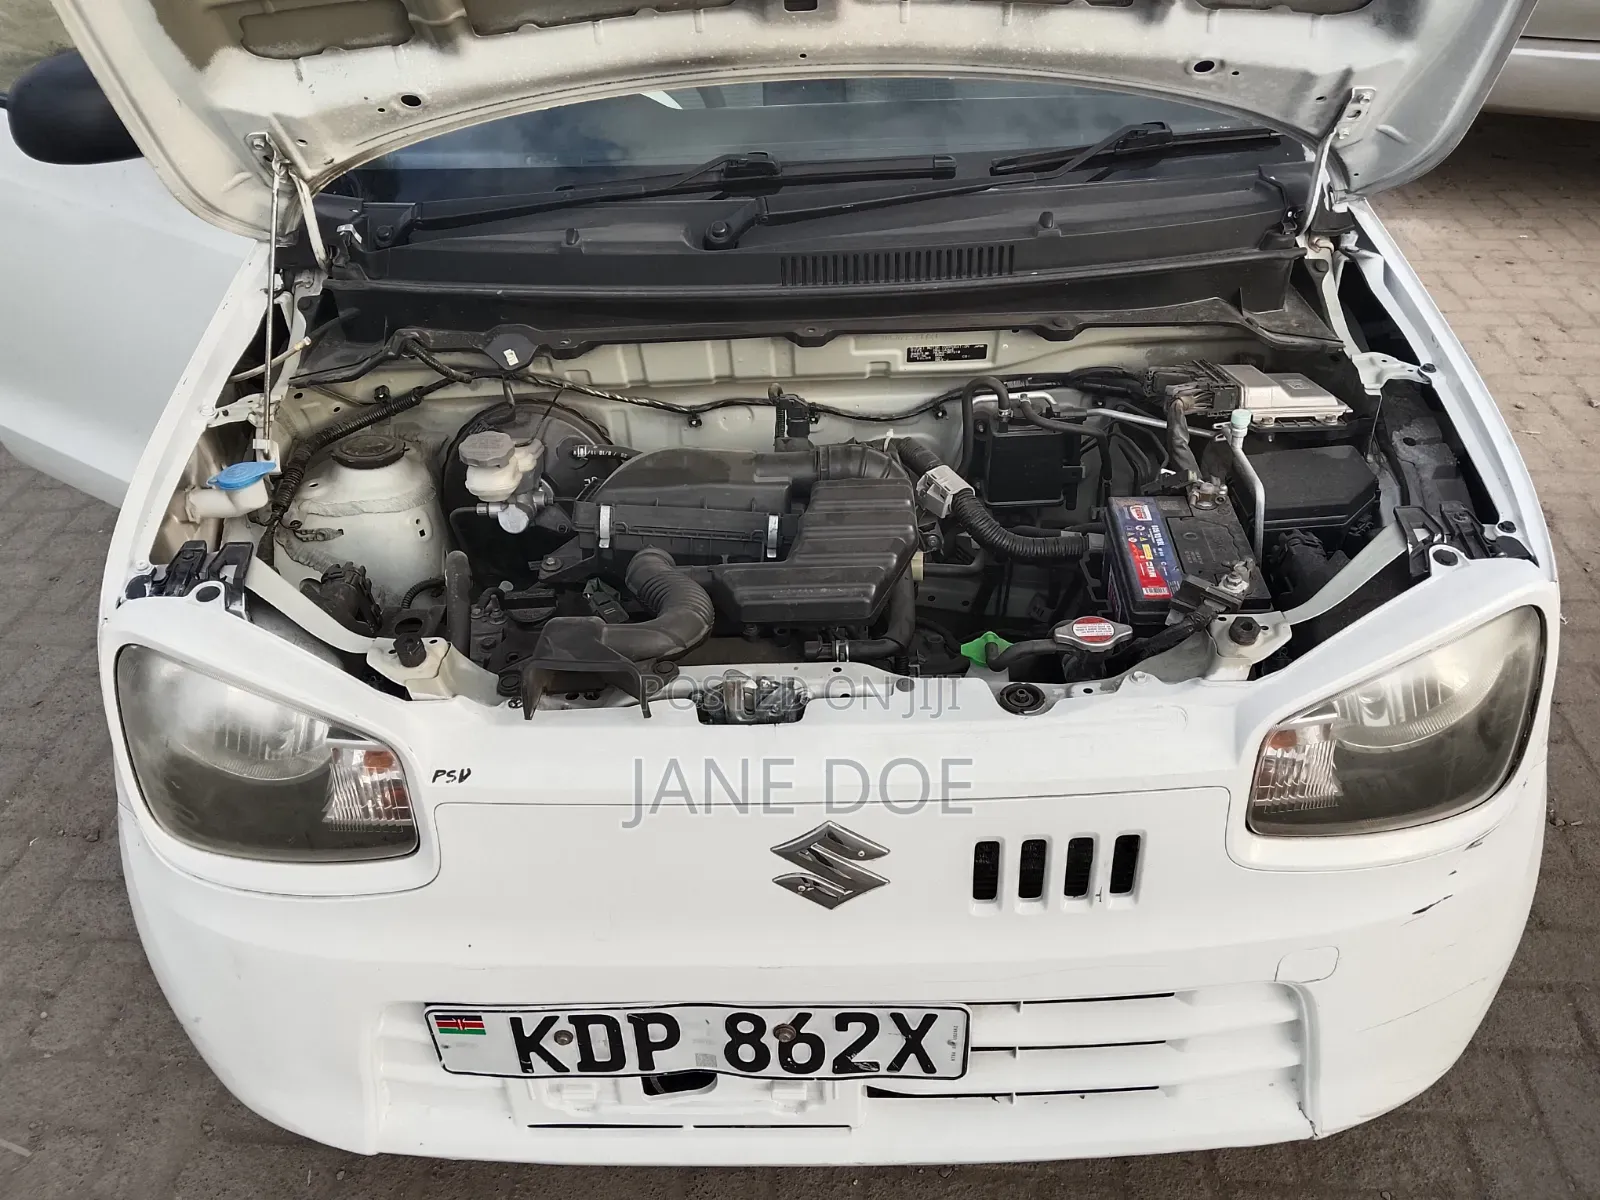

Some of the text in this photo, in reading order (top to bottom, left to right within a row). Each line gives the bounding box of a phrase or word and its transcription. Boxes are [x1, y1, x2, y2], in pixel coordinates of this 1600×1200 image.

[431, 767, 472, 784] PSV
[509, 1012, 681, 1074] KDP
[723, 1011, 939, 1075] 862X
